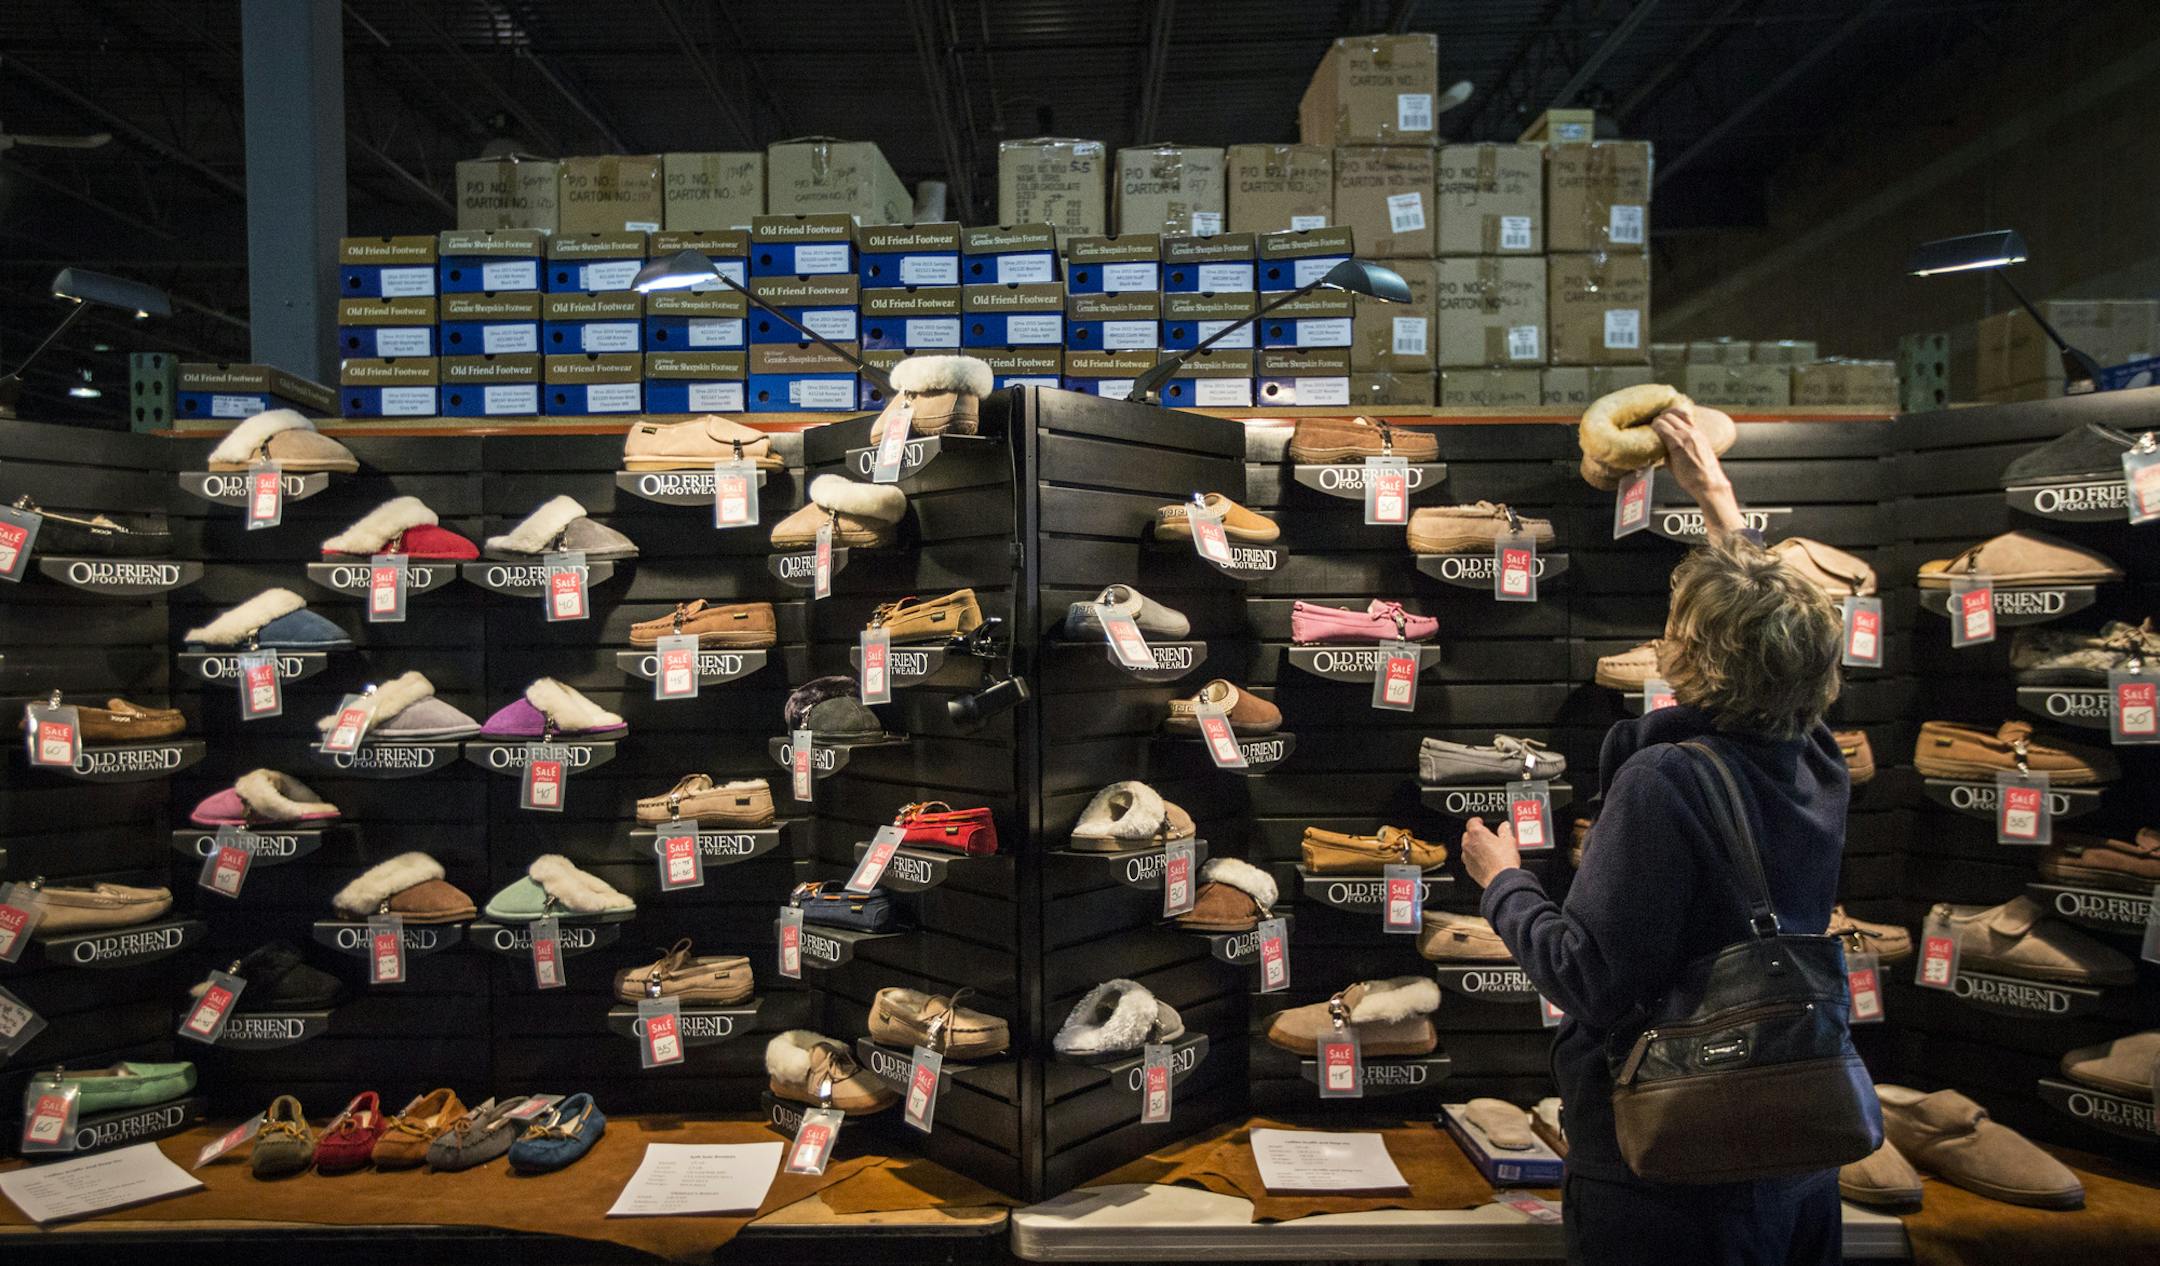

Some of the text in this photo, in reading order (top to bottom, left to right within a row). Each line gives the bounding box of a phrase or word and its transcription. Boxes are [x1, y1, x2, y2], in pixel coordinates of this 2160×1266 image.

[761, 224, 844, 235] Old Friend Footwear
[869, 234, 954, 246] Old Friend Footwear
[348, 246, 427, 255] Old Friend Footwear
[758, 286, 849, 296] Old Friend Footwear
[872, 299, 955, 308] Old Friend Footwear
[973, 294, 1057, 305] Old Friend Footwear
[553, 302, 634, 312] Old Friend Footwear
[989, 358, 1055, 368] Friend Footwear
[1073, 359, 1150, 368] Old Friend Footwear
[350, 367, 429, 376] Old Friend Footwear
[451, 366, 532, 375] Old Friend Footwear
[260, 479, 277, 489] SALE
[641, 475, 680, 495] OLD
[1319, 468, 1358, 489] OLD
[204, 476, 243, 496] OLD
[723, 483, 742, 493] SALE
[1379, 480, 1399, 491] SALE
[2034, 488, 2084, 512] OLD
[1663, 514, 1703, 535] OLD
[1201, 526, 1220, 538] SALE
[1243, 549, 1276, 570] FRIEND
[1506, 554, 1526, 565] SALE
[70, 562, 178, 585] OLD FRIEND
[780, 557, 801, 578] OLD
[1442, 558, 1482, 579] OLD
[92, 576, 161, 585] FOOTWEAR
[332, 567, 371, 587] OLD
[376, 572, 394, 584] SALE
[488, 566, 525, 587] OLD
[556, 578, 576, 588] SALE
[1966, 597, 1986, 607] SALE
[1995, 592, 2064, 614] FRIEND
[1856, 616, 1874, 627] SALE
[667, 654, 688, 664] SALE
[868, 651, 882, 660] SALE
[1153, 647, 1192, 669] FRIEND
[1314, 652, 1353, 672] OLD
[203, 657, 241, 678] OLD
[889, 652, 928, 675] FRIEND
[1392, 663, 1412, 675] SALE
[251, 670, 271, 682] SALE
[2124, 688, 2150, 700] SALE
[2046, 693, 2096, 716] OLD
[344, 713, 362, 724] SALE
[44, 726, 68, 737] SALE
[1209, 723, 1224, 733] SALE
[335, 748, 434, 768] OLD FRIEND
[490, 747, 528, 768] OLD
[1250, 741, 1283, 763] FRIEND
[73, 748, 181, 775] OLD FRIEND
[95, 760, 164, 774] FOOTWEAR
[536, 766, 556, 777] SALE
[1446, 792, 1485, 813] OLD
[1951, 786, 1995, 808] OLD
[2010, 793, 2035, 804] SALE
[1517, 805, 1537, 815] SALE
[670, 843, 690, 853] SALE
[698, 835, 754, 854] FRIEND
[223, 852, 243, 865] SALE
[893, 855, 931, 884] FRIEND
[1127, 857, 1153, 882] OLD
[1170, 864, 1186, 877] SALE
[1328, 883, 1367, 903] OLD
[1391, 884, 1411, 895] SALE
[2055, 892, 2104, 916] OLD
[0, 910, 22, 926] SALE
[74, 928, 183, 963] OLD FRIEND
[378, 940, 395, 951] SALE
[495, 930, 532, 950] OLD
[1226, 934, 1249, 959] OLD
[96, 943, 167, 960] FOOTWEAR
[537, 944, 552, 955] SALE
[807, 935, 840, 962] FRIEND
[1265, 943, 1280, 955] SALE
[1462, 972, 1500, 992] OLD
[1853, 975, 1873, 987] SALE
[209, 993, 229, 1005] SALE
[1953, 976, 2069, 1013] OLD FRIEND
[1972, 992, 2049, 1011] FOOTWEAR
[245, 1018, 303, 1038] FRIEND
[652, 1020, 672, 1033] SALE
[1329, 1049, 1350, 1059] SALE
[871, 1051, 894, 1074] OLD
[918, 1070, 933, 1088] SALE
[1150, 1074, 1164, 1085] SALE
[1368, 1065, 1427, 1084] FRIEND
[42, 1100, 66, 1113] SALE
[2068, 1094, 2118, 1118] OLD
[75, 1106, 184, 1151] OLD FRIEND
[97, 1122, 167, 1146] FOOTWEAR
[806, 1128, 827, 1141] SALE
